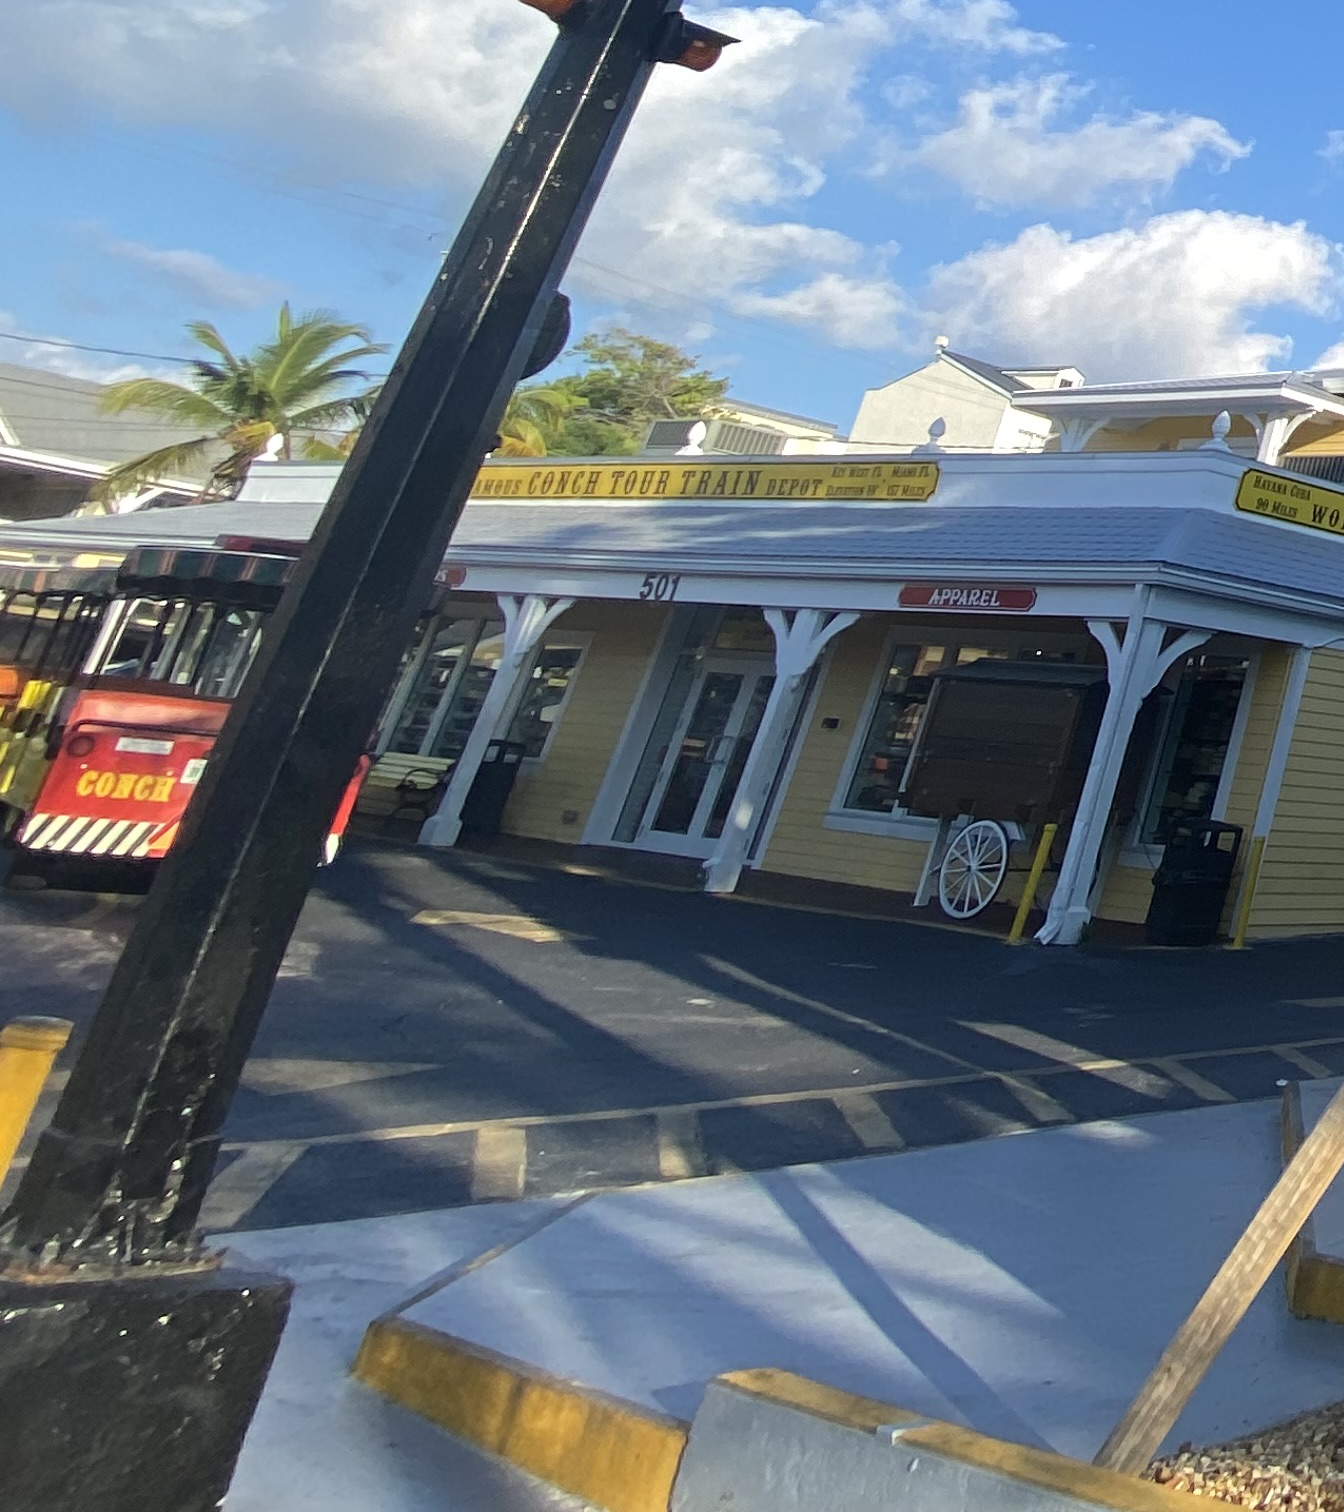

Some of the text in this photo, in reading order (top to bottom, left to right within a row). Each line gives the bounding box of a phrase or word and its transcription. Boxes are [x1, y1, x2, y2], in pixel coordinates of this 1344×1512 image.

[472, 470, 824, 496] AMOUS CONCH TOUR TRAIN DEPOT
[1255, 497, 1299, 518] 90 MILES
[639, 572, 682, 601] 501
[927, 588, 1001, 608] APPAREL
[76, 770, 177, 803] CONCH
